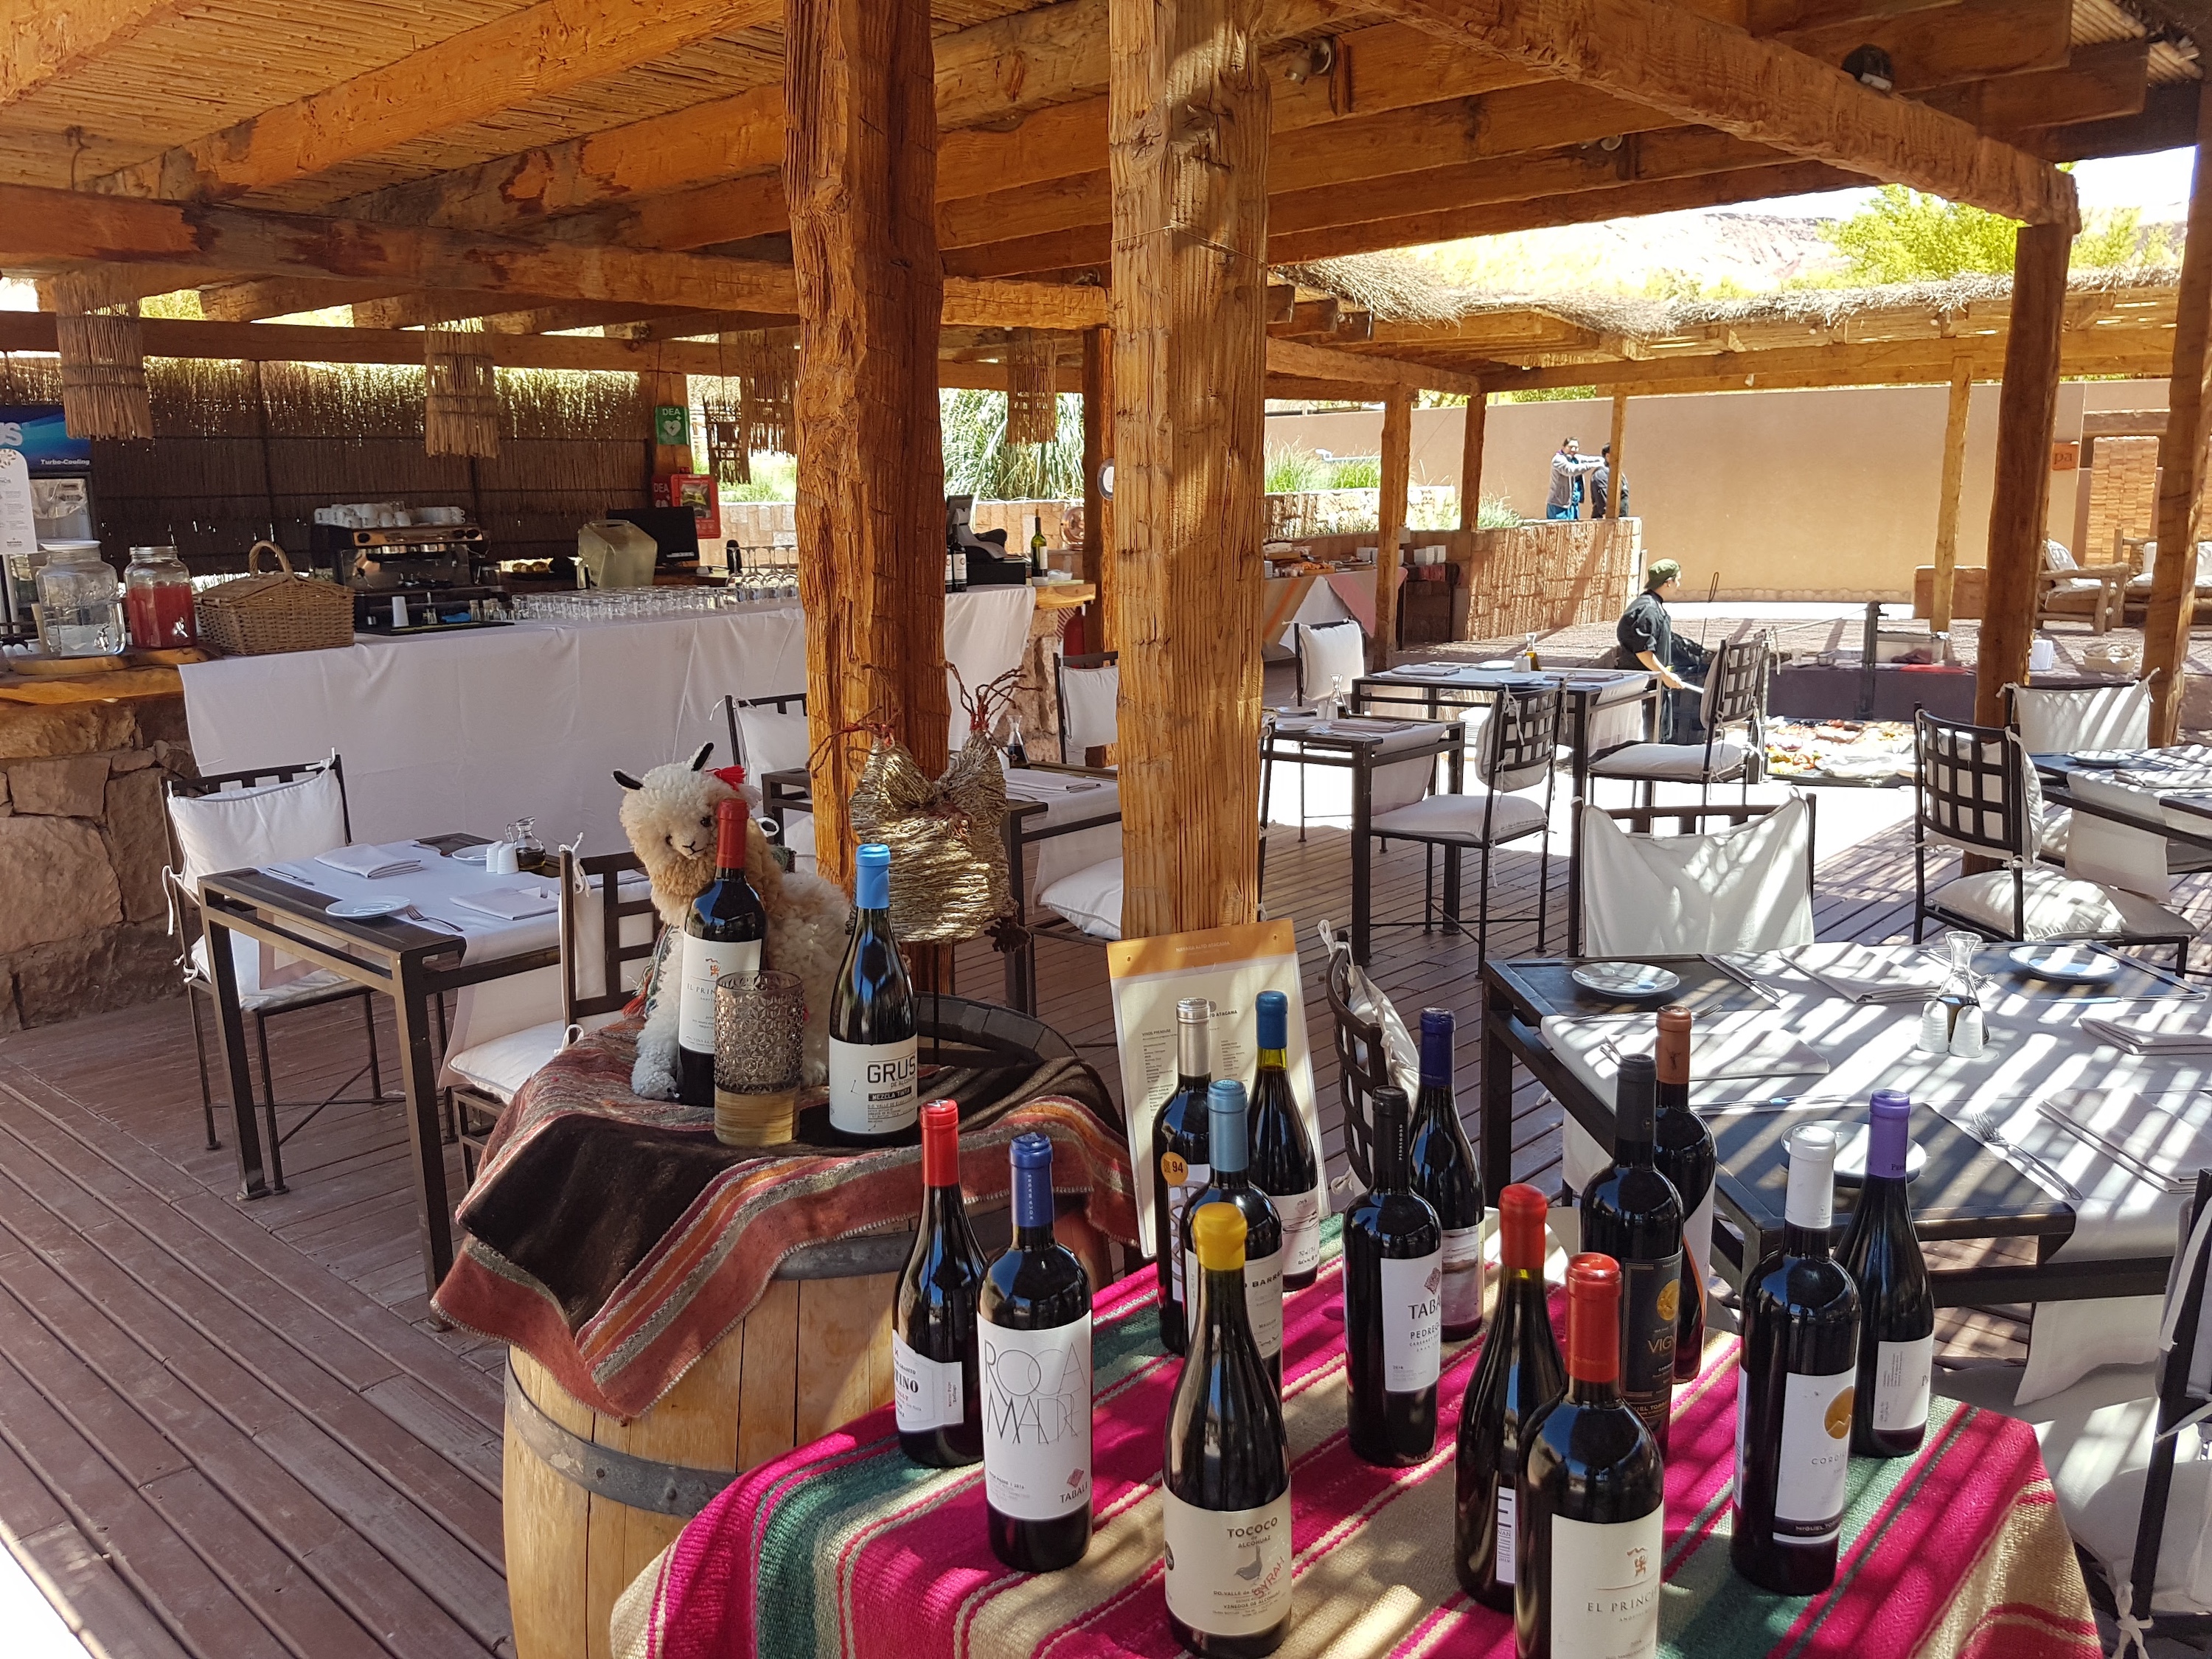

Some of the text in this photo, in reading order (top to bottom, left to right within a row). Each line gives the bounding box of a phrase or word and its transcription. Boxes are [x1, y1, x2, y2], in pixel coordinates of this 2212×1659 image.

[662, 408, 681, 416] DEA
[653, 482, 669, 493] DEA
[687, 983, 693, 991] EL
[867, 1055, 916, 1083] GRUS
[872, 1092, 896, 1101] MEZCLA
[1172, 1161, 1183, 1173] 94
[984, 1338, 1085, 1407] ROCA
[894, 1368, 919, 1393] TINO
[987, 1388, 1085, 1445] MADRE
[1226, 1517, 1278, 1538] TOCOCO
[1238, 1534, 1271, 1548] ALCOHUAZ
[1253, 1556, 1284, 1599] SYRAH
[1587, 1602, 1602, 1613] EL
